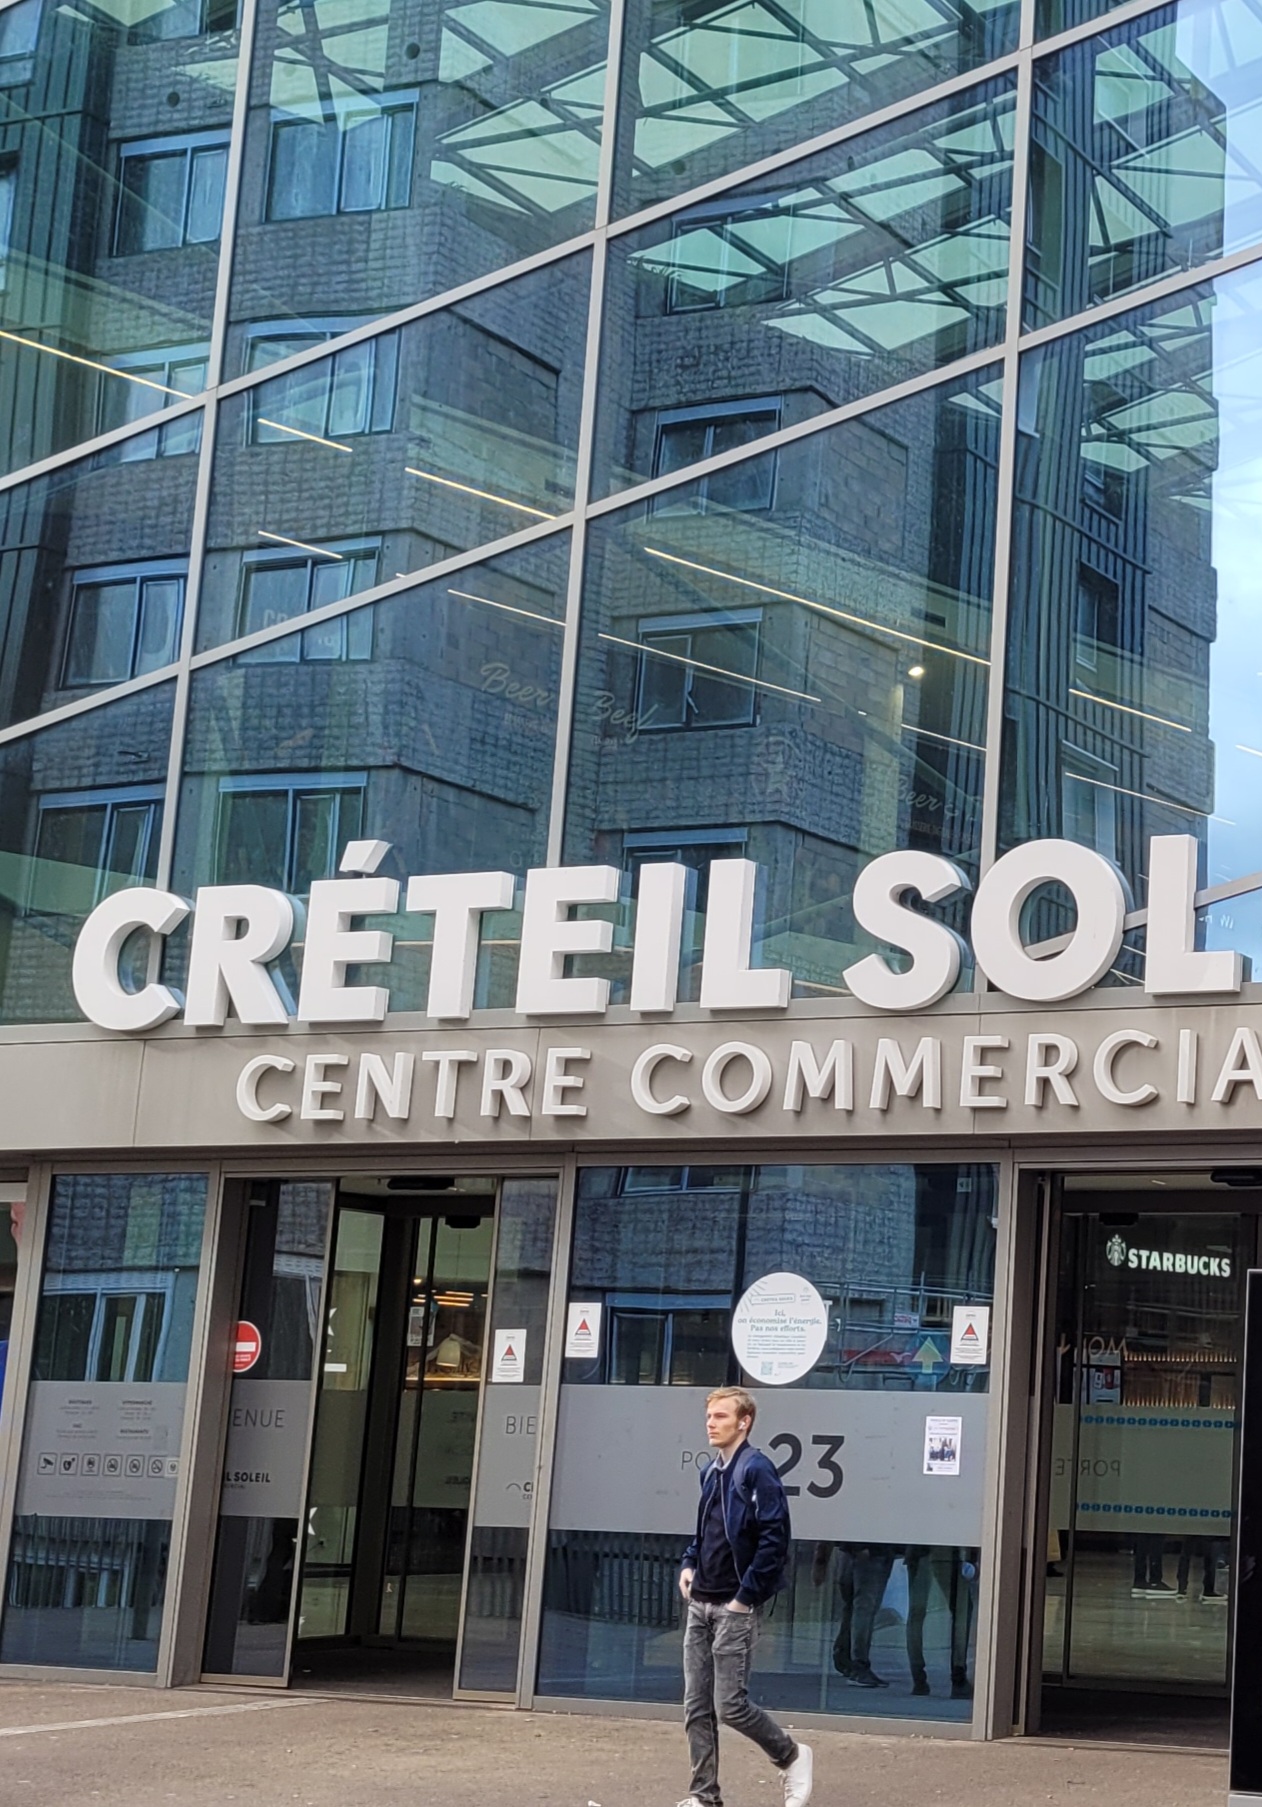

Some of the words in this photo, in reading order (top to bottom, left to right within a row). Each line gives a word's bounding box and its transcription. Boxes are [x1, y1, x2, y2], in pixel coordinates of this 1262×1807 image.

[72, 839, 792, 1032] CRÉTEIL
[236, 1047, 592, 1123] CENTRE
[1127, 1247, 1232, 1278] STARBUCKS
[234, 1471, 271, 1484] SOLEIL
[768, 1432, 845, 1499] 23
